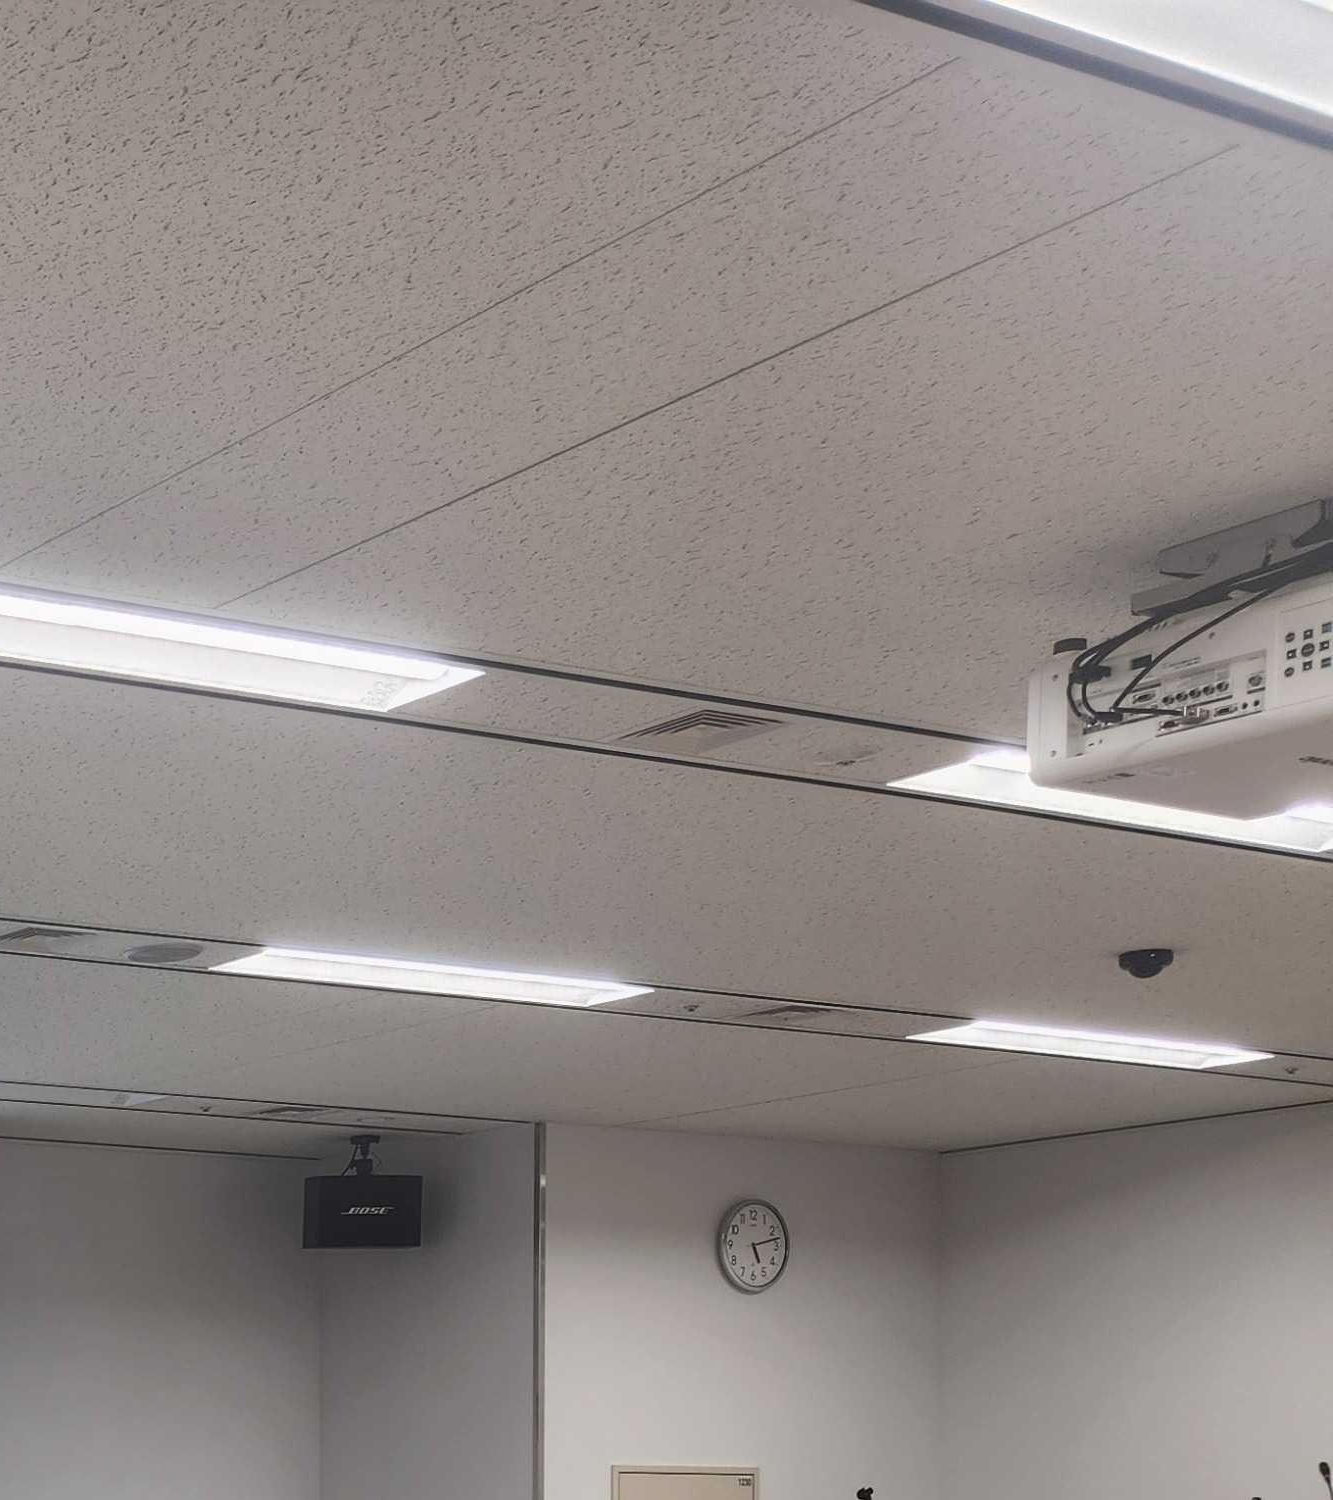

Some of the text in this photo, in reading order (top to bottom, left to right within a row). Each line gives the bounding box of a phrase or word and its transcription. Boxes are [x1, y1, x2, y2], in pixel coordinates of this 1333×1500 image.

[341, 1206, 395, 1215] BOSE
[749, 1209, 758, 1221] 12
[769, 1225, 776, 1236] 2
[728, 1239, 733, 1250] 9
[731, 1255, 737, 1266] 8
[770, 1256, 776, 1266] 4
[740, 1266, 746, 1277] 7
[750, 1270, 757, 1281] 6
[761, 1266, 767, 1277] 5
